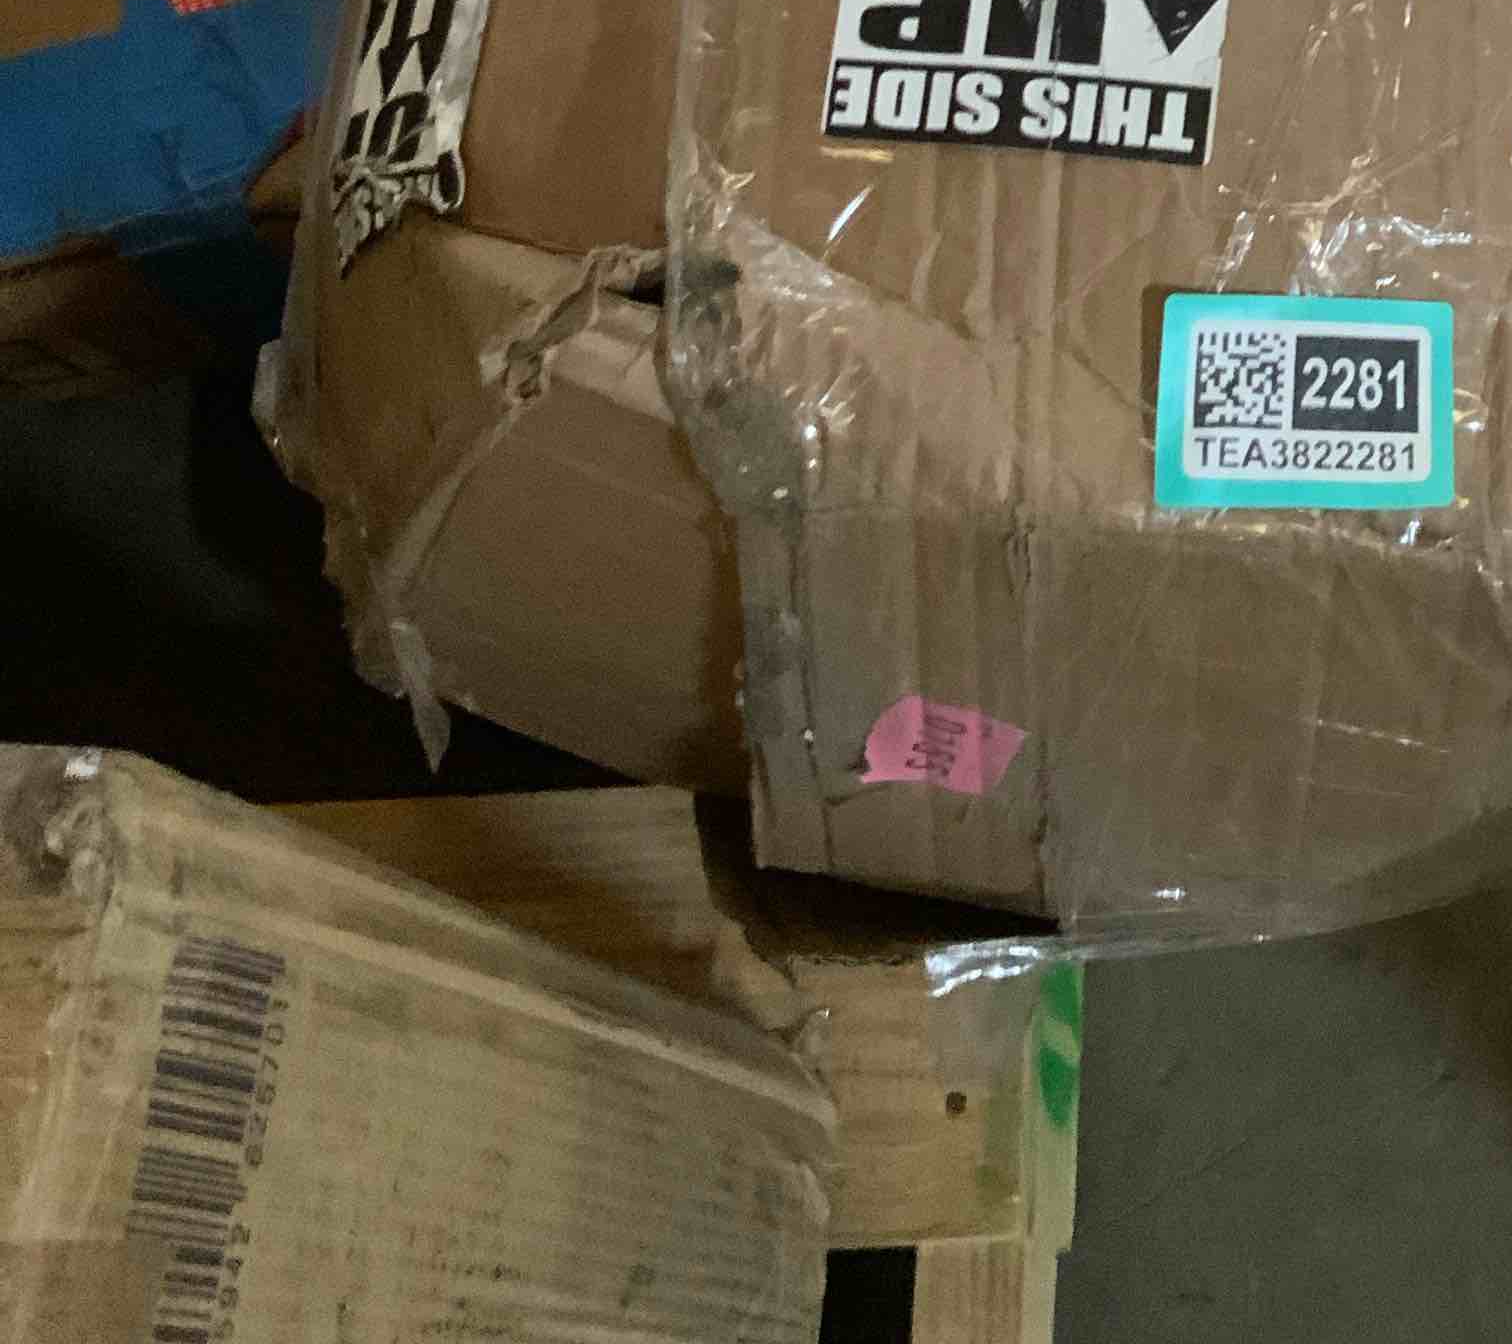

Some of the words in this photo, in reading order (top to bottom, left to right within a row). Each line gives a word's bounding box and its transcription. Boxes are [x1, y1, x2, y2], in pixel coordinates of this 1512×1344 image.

[830, 66, 1003, 135] SIDE
[1020, 76, 1195, 153] THIS
[1301, 357, 1407, 411] 2281
[1194, 437, 1416, 472] TEA3822281
